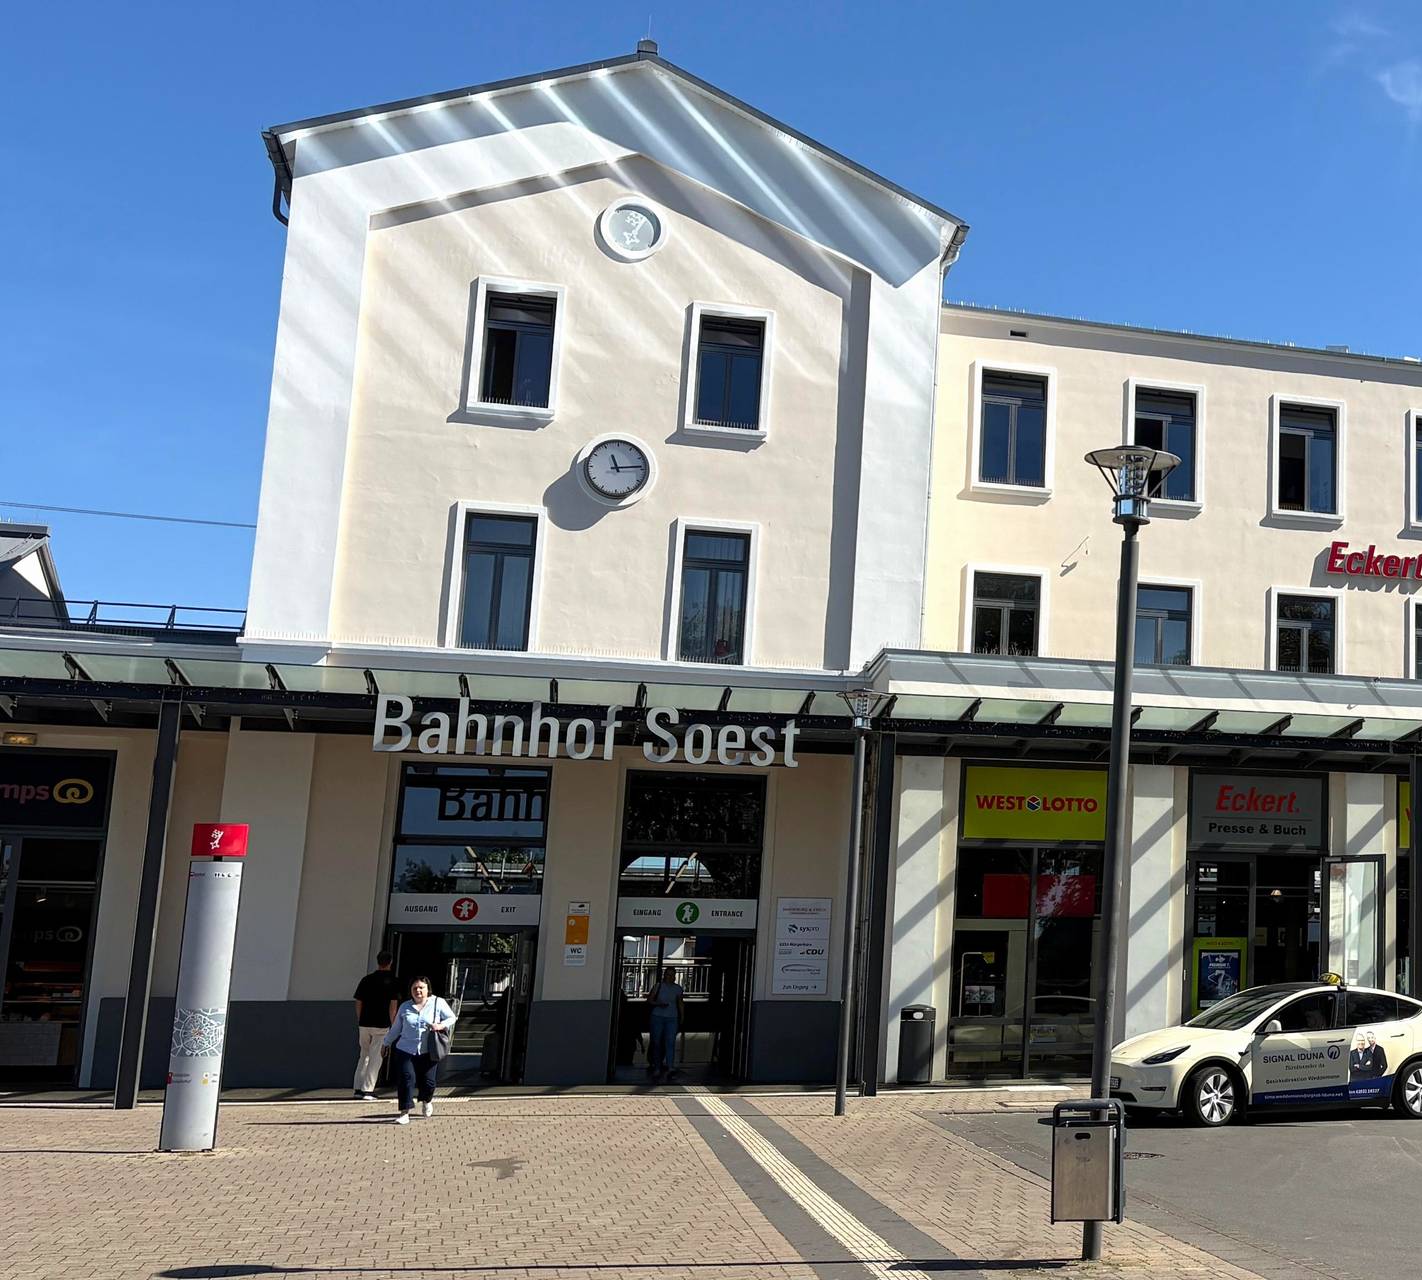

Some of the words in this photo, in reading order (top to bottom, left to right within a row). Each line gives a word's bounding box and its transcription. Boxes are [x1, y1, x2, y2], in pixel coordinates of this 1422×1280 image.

[372, 693, 623, 761] Bahnhof
[643, 706, 801, 768] Soest
[976, 795, 1026, 810] WEST
[1042, 797, 1098, 812] LOTTO
[1208, 822, 1254, 834] Presse
[1259, 824, 1269, 834] &
[1273, 825, 1307, 835] Buch
[404, 905, 438, 913] AUSGANG
[711, 910, 744, 918] ENTRANCE
[1263, 1054, 1295, 1064] SIGNAL
[1297, 1052, 1325, 1061] IDUNA
